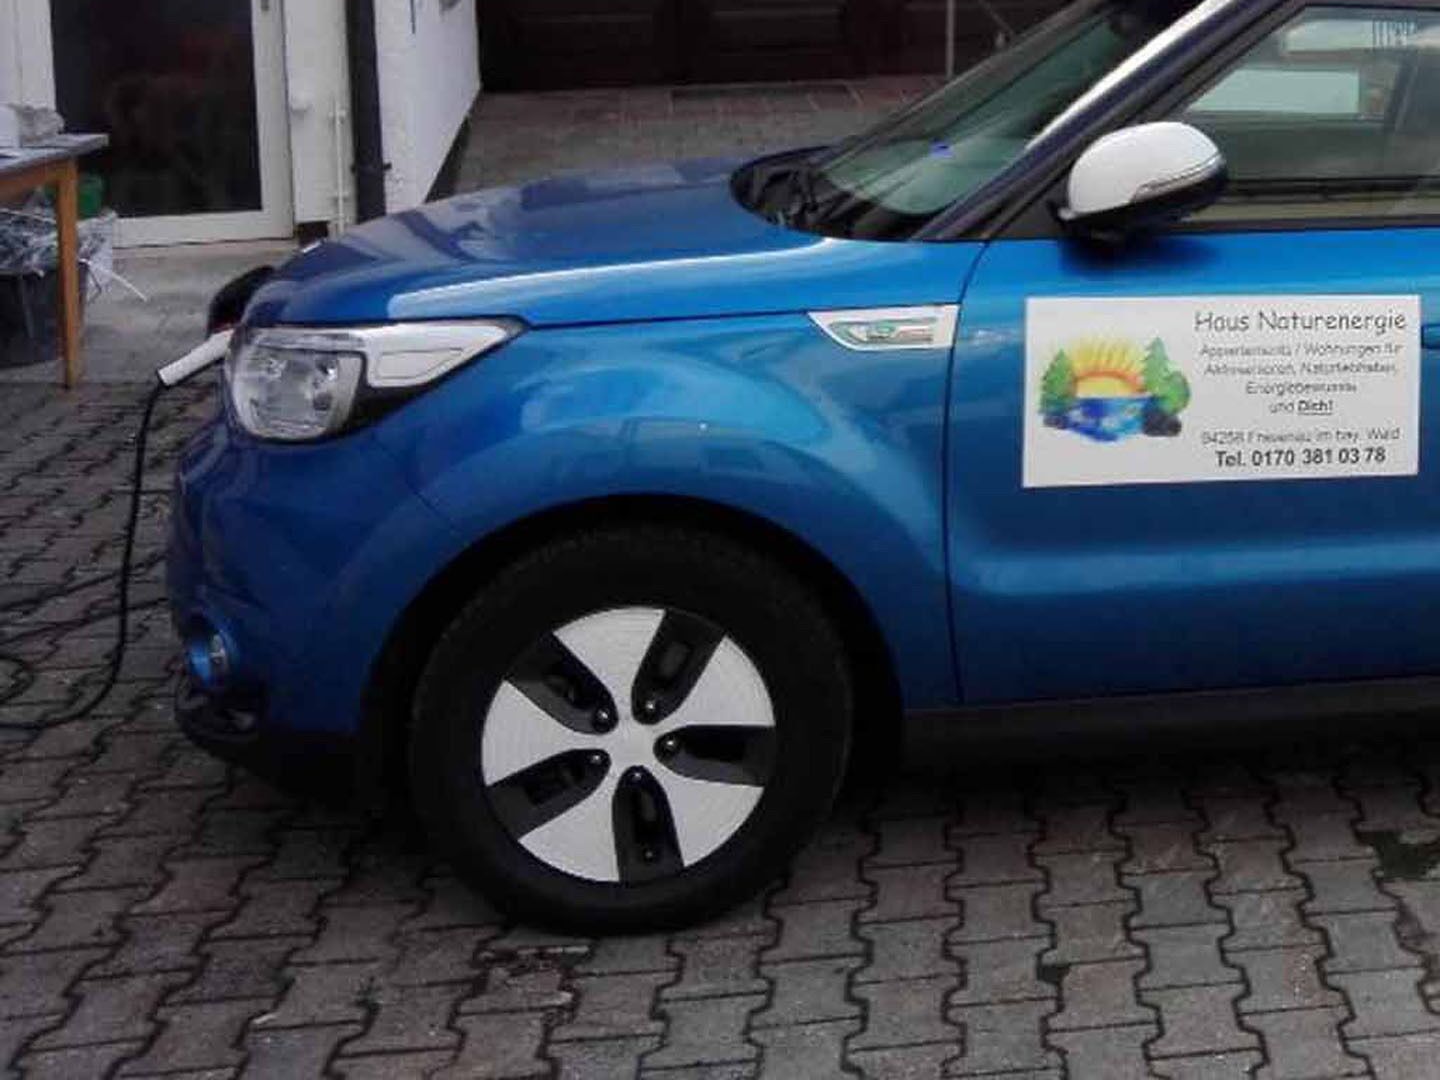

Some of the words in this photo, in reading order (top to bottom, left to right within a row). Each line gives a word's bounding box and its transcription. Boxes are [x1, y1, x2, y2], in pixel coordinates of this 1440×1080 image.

[1194, 310, 1250, 333] Haus
[1258, 308, 1407, 336] Naturenergie
[1215, 450, 1246, 468] Tel.
[1252, 449, 1295, 467] 0170
[1302, 448, 1333, 465] 381
[1338, 447, 1360, 464] 03
[1365, 446, 1386, 464] 78
